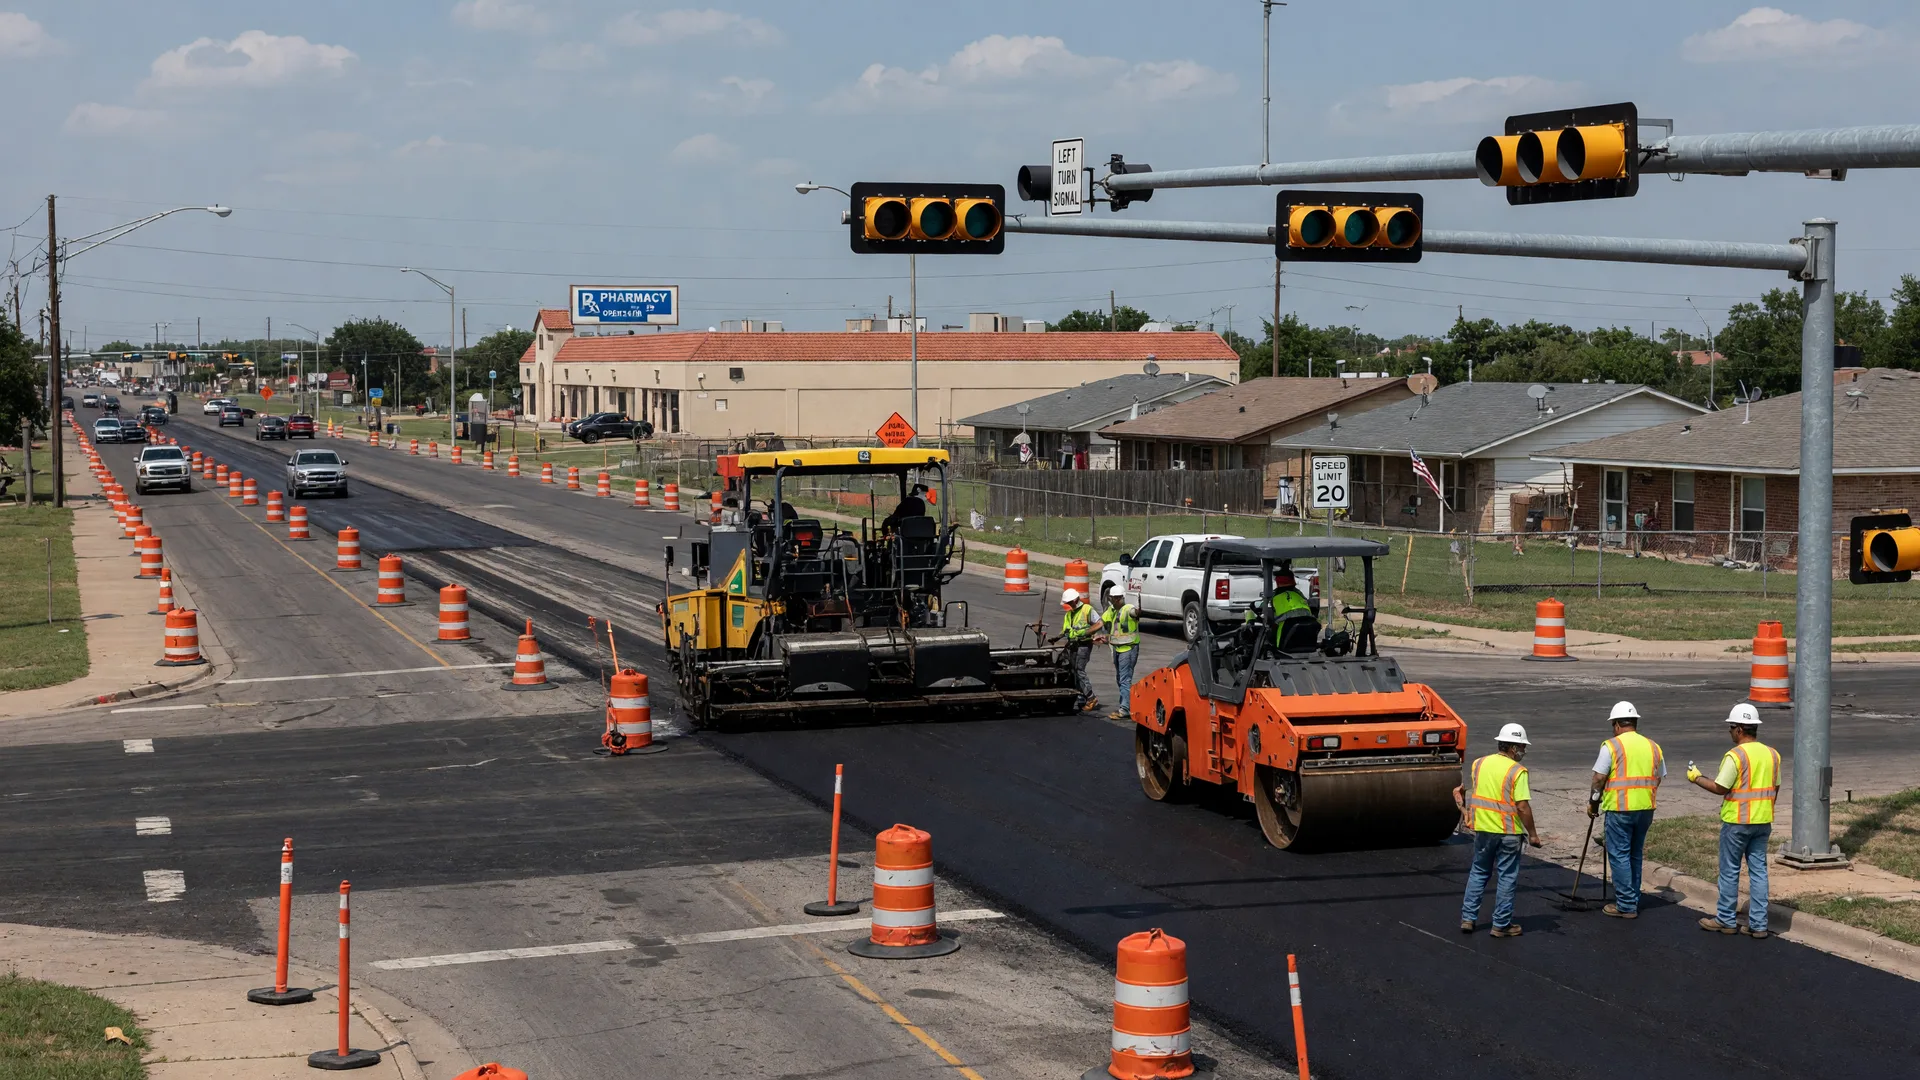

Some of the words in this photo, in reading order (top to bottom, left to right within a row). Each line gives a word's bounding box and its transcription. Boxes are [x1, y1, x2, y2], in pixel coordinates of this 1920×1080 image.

[1058, 147, 1076, 164] LEFT
[1058, 169, 1077, 185] TURN
[1053, 190, 1079, 207] SIGNAL
[600, 292, 668, 303] PHARMACY
[1314, 461, 1346, 470] SPEED
[1316, 484, 1345, 502] 20
